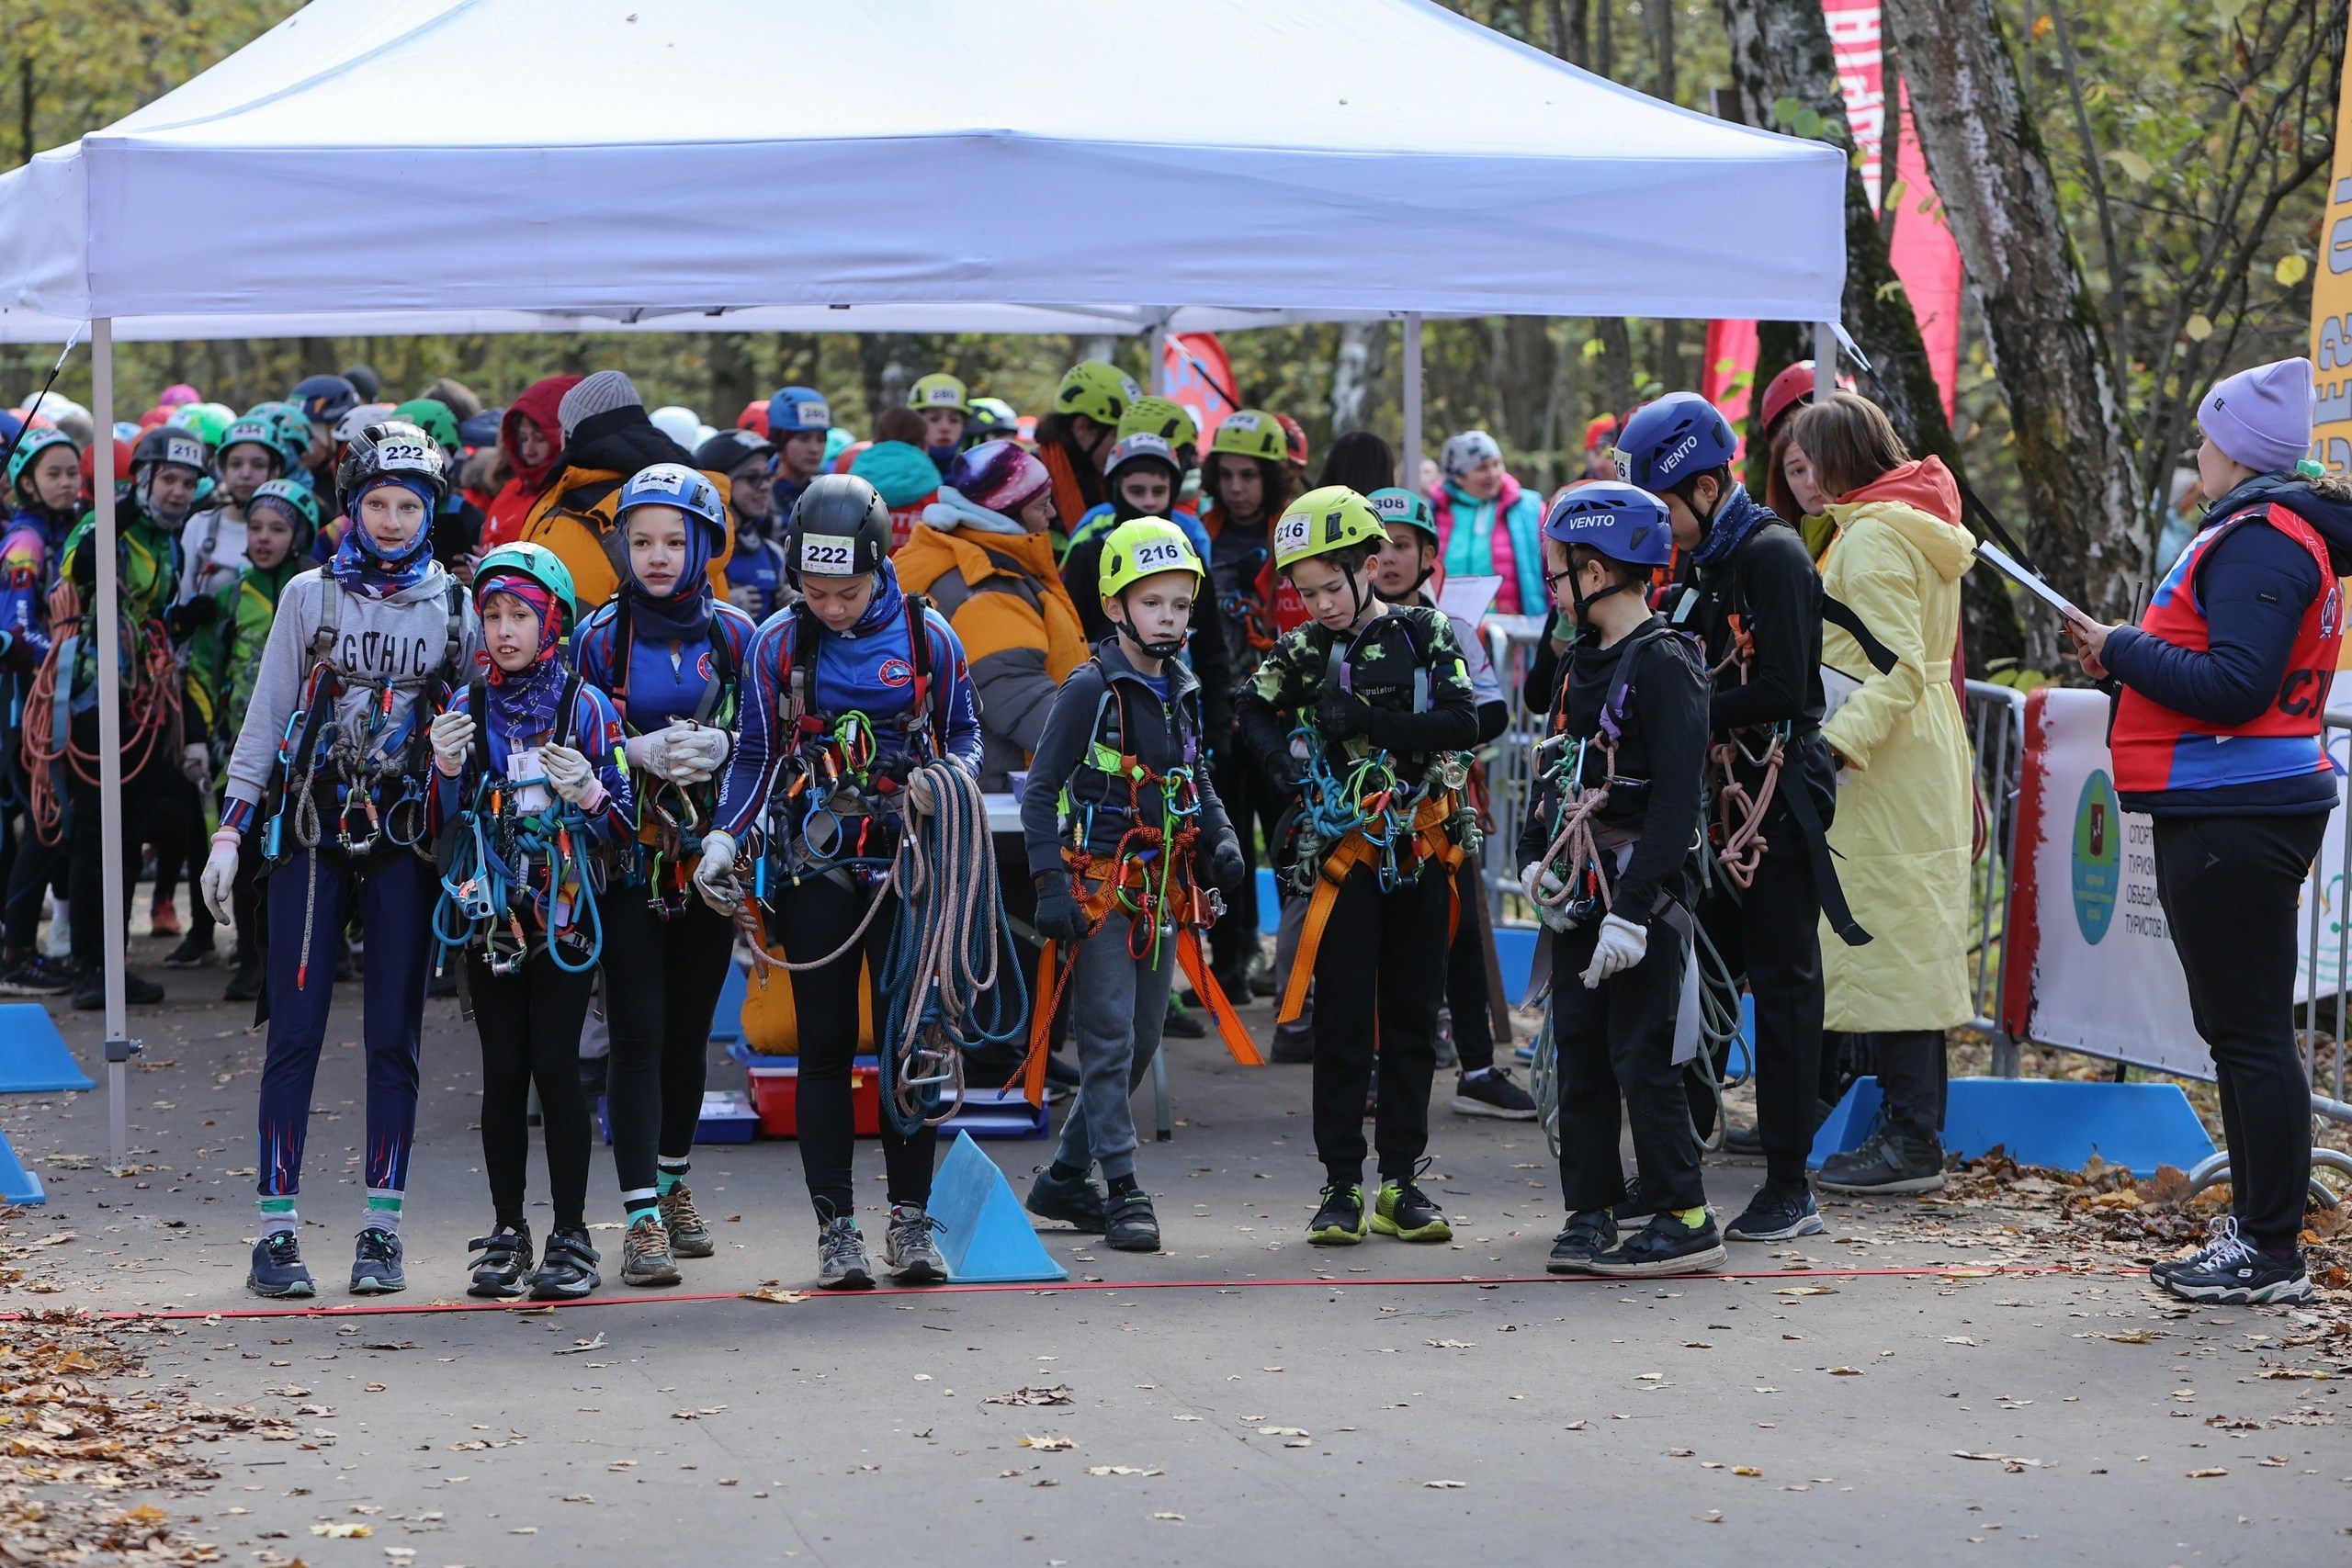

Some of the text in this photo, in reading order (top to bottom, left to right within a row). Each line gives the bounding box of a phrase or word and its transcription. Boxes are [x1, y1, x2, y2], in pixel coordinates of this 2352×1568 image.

[174, 444, 198, 458] 211
[386, 446, 424, 460] 222
[1659, 435, 1698, 474] VENTO
[638, 472, 677, 485] 222
[1374, 499, 1405, 510] 308
[1569, 515, 1615, 530] VENTO
[1276, 523, 1305, 543] 216
[808, 546, 847, 564] 222
[1139, 545, 1178, 564] 216
[343, 631, 426, 677] GOTHIC
[2125, 913, 2162, 939] ТУРИСТОВ
